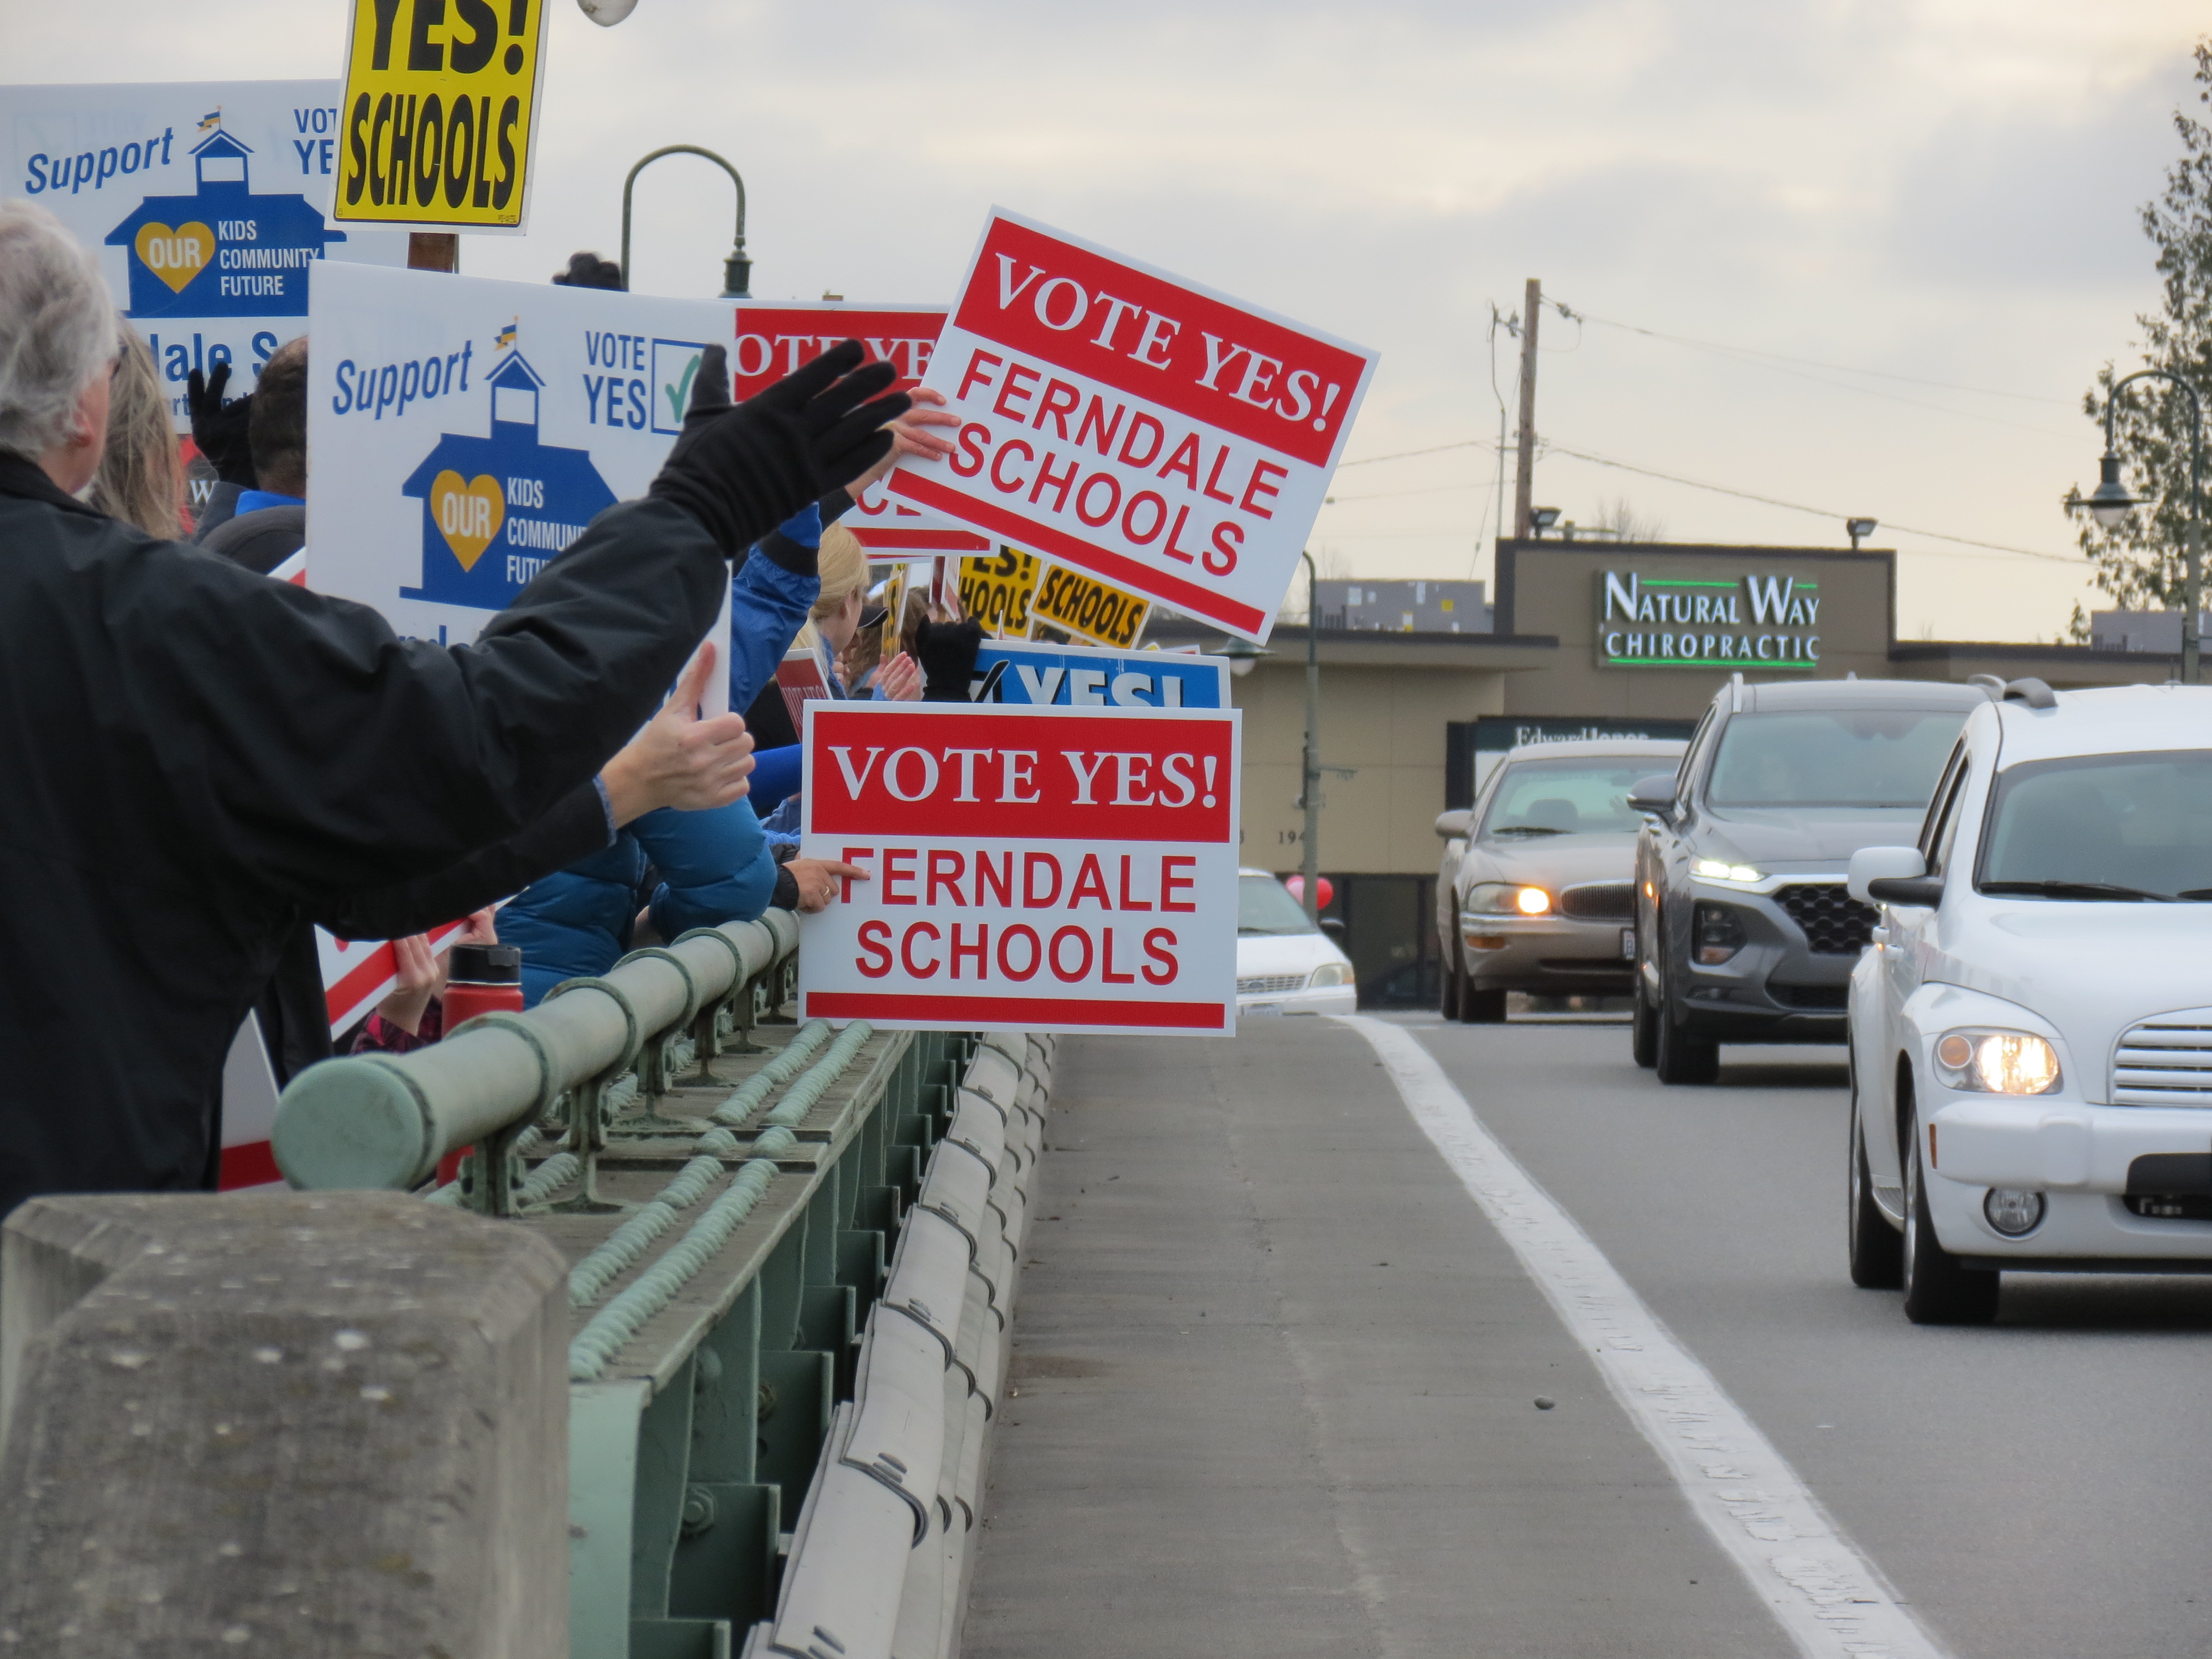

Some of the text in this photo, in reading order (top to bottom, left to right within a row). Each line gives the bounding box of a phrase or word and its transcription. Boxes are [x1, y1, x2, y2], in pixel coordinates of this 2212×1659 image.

[25, 127, 174, 194] Support
[346, 92, 520, 210] SCHOOLS
[149, 238, 201, 268] OUR
[218, 220, 257, 241] KIDS
[220, 248, 320, 269] COMMUNITY
[221, 275, 284, 296] FUTURE
[586, 331, 645, 371] VOTE
[995, 253, 1340, 432] VOTE YES!
[332, 340, 472, 420] Support
[582, 374, 646, 430] YES
[957, 348, 1289, 520] FERNDALE
[443, 492, 491, 539] OUR
[507, 477, 544, 509] KIDS
[949, 422, 1245, 576] SCHOOLS
[507, 517, 587, 551] COMMUN
[1038, 568, 1144, 645] SCHOOLS
[1606, 632, 1820, 660] CHIROPRACTIC
[828, 746, 1218, 808] VOTE YES!
[840, 847, 1197, 913] FERNDALE
[855, 920, 1180, 986] SCHOOLS
